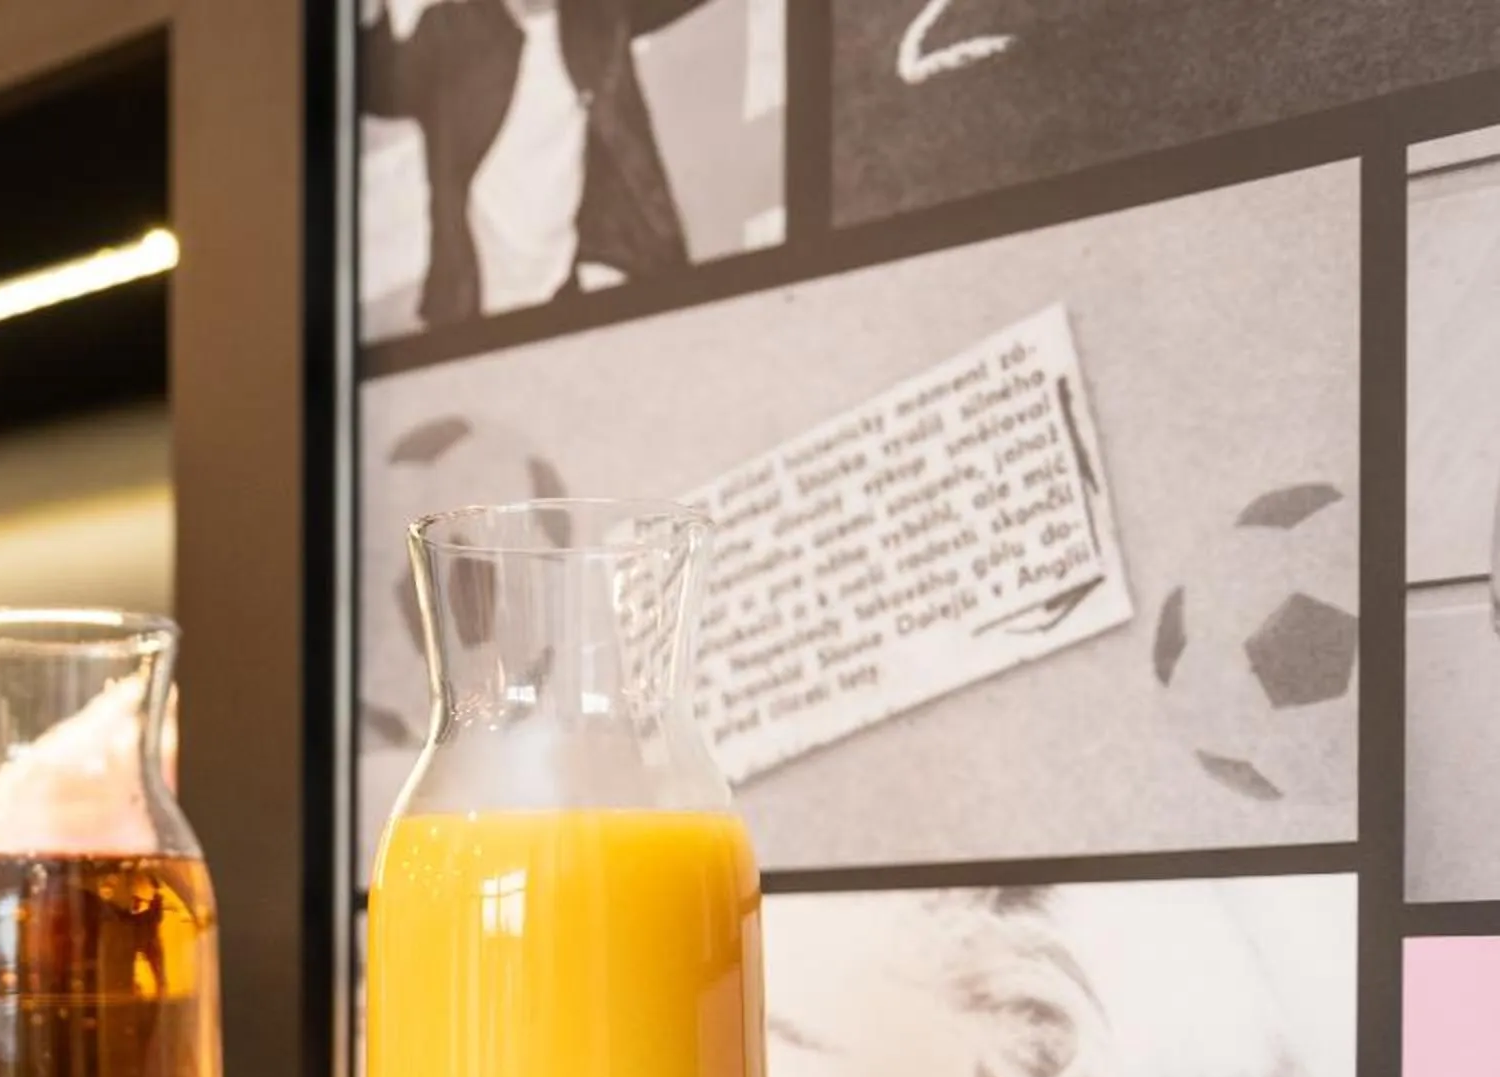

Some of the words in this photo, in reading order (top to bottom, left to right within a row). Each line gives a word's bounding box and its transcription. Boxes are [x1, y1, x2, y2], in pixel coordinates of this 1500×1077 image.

[897, 362, 986, 418] moment
[959, 362, 1045, 421] silného
[944, 391, 1050, 458] směřoval
[994, 421, 1058, 474] jehož
[971, 477, 1009, 510] ale
[1022, 453, 1065, 489] míč
[990, 479, 1072, 534] skončil
[1039, 509, 1081, 546] do-
[1015, 538, 1091, 589] Anglii
